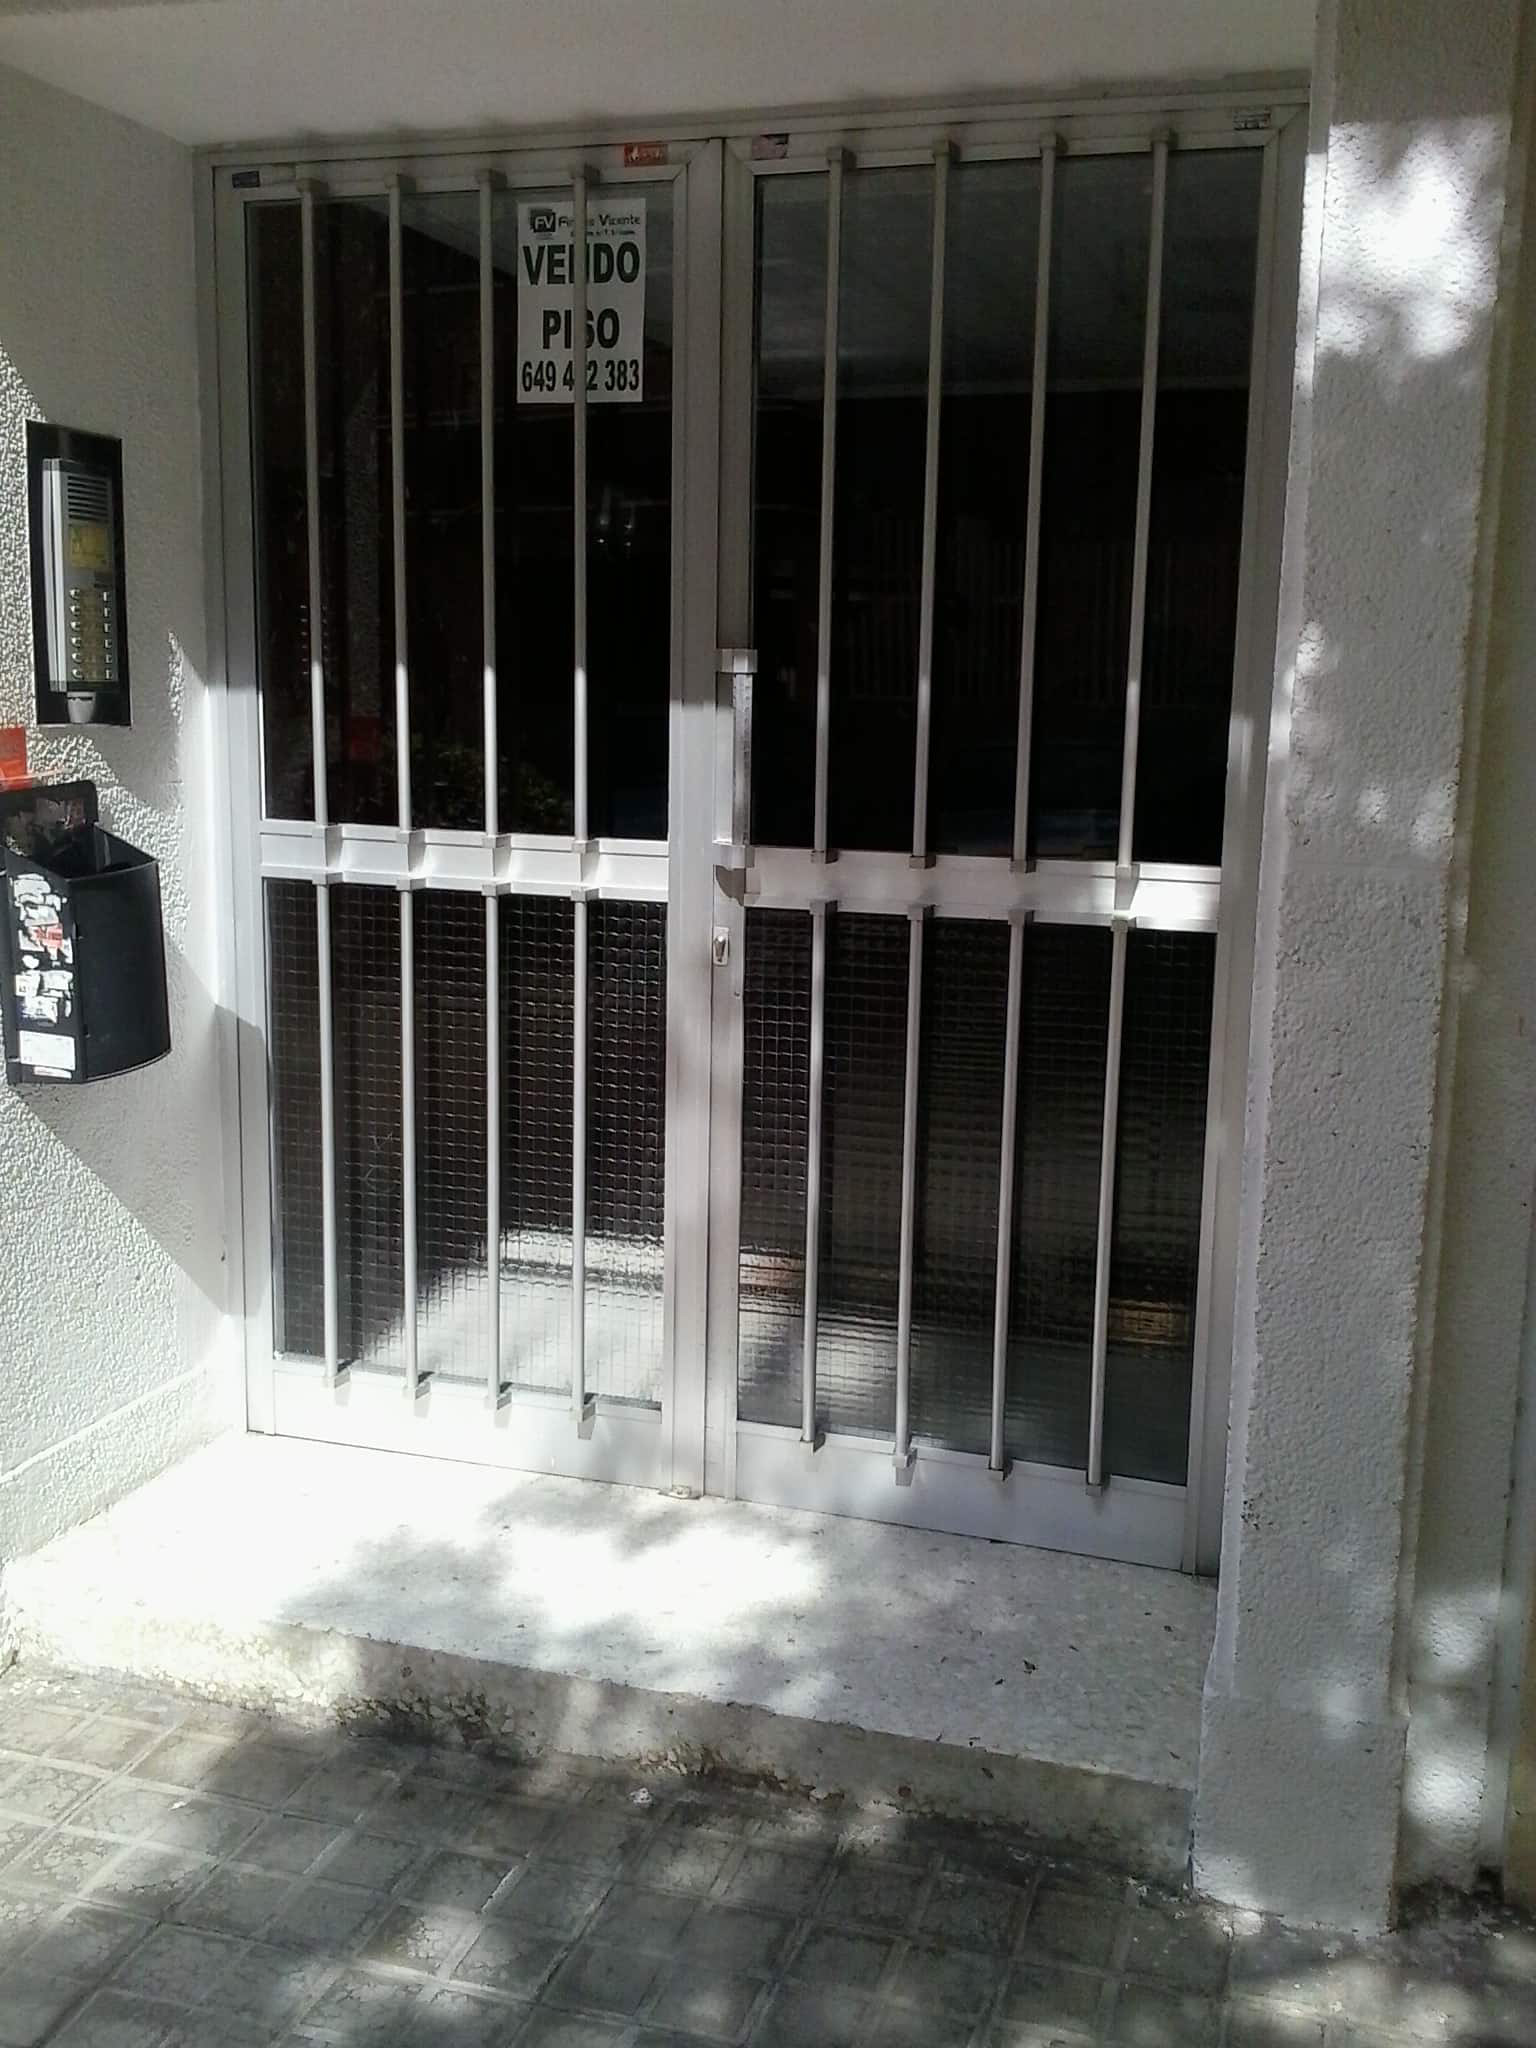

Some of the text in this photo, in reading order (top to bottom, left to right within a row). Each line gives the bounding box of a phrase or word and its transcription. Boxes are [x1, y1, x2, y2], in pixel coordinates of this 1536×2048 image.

[535, 215, 554, 229] FV
[523, 242, 640, 285] VENDO
[522, 359, 639, 391] 649 42 383
